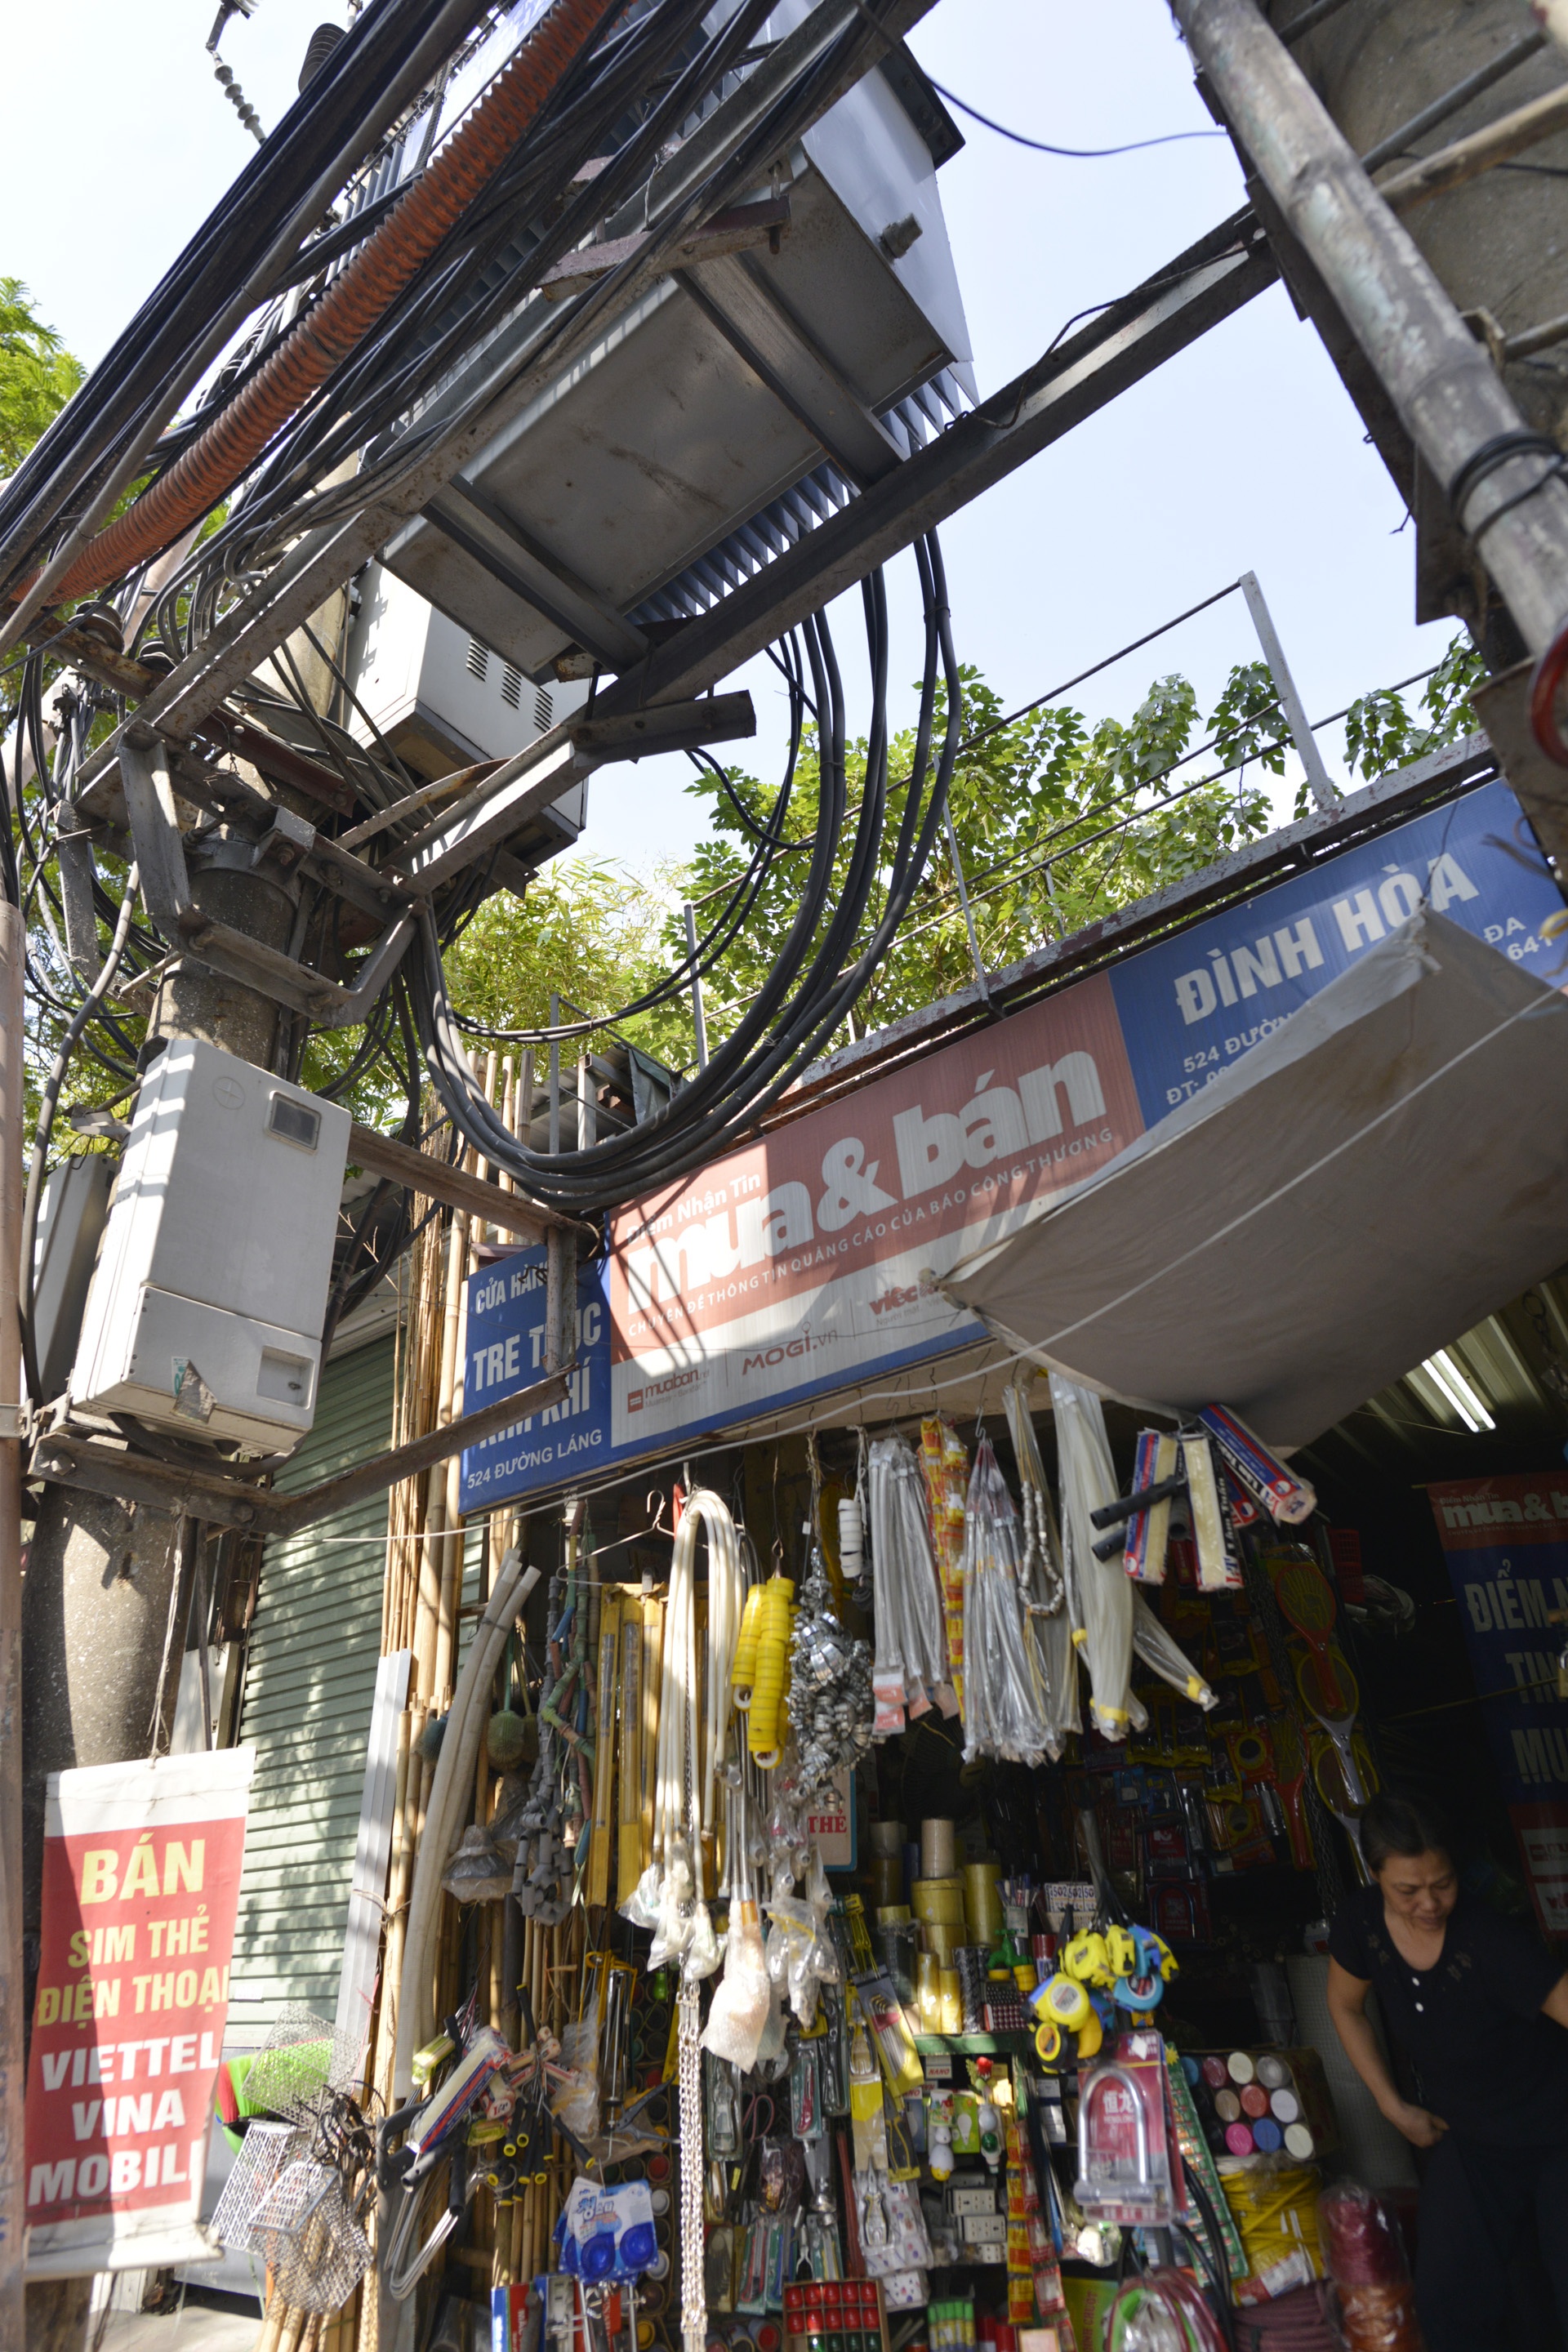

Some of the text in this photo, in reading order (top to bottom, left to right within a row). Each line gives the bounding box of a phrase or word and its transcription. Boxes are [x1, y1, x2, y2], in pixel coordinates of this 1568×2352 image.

[1174, 853, 1479, 1025] ĐÌNH HÒA
[1183, 1045, 1219, 1073] 524
[626, 1174, 760, 1245] Điểm Nhận Tin
[627, 1051, 1107, 1316] mua & bán
[628, 1307, 684, 1337] CHUYÊN
[708, 1276, 759, 1307] THÔNG
[761, 1264, 786, 1285] TIN
[791, 1239, 849, 1272] QUẢNG
[853, 1223, 885, 1246] CÁO
[891, 1209, 925, 1230] CỦA
[930, 1189, 965, 1214] BÁO
[971, 1164, 1023, 1197] CÔNG
[1027, 1127, 1114, 1175] THƯƠNG
[475, 1261, 547, 1314] CỬA HÀN
[473, 1334, 520, 1391] TRE
[467, 1468, 491, 1489] 524
[494, 1446, 553, 1480] ĐƯỜNG
[558, 1428, 602, 1459] LÁNG
[1441, 1500, 1525, 1529] mua
[1463, 1559, 1552, 1633] ĐIỂM
[808, 1808, 847, 1833] THẺ
[80, 1833, 206, 1905] BÁN
[1053, 1886, 1067, 1898] 502
[69, 1904, 210, 1968] SIM THẺ
[37, 1974, 121, 2029] ĐIỆN
[41, 2030, 219, 2091] VIETTEL
[71, 2089, 185, 2141] VINA
